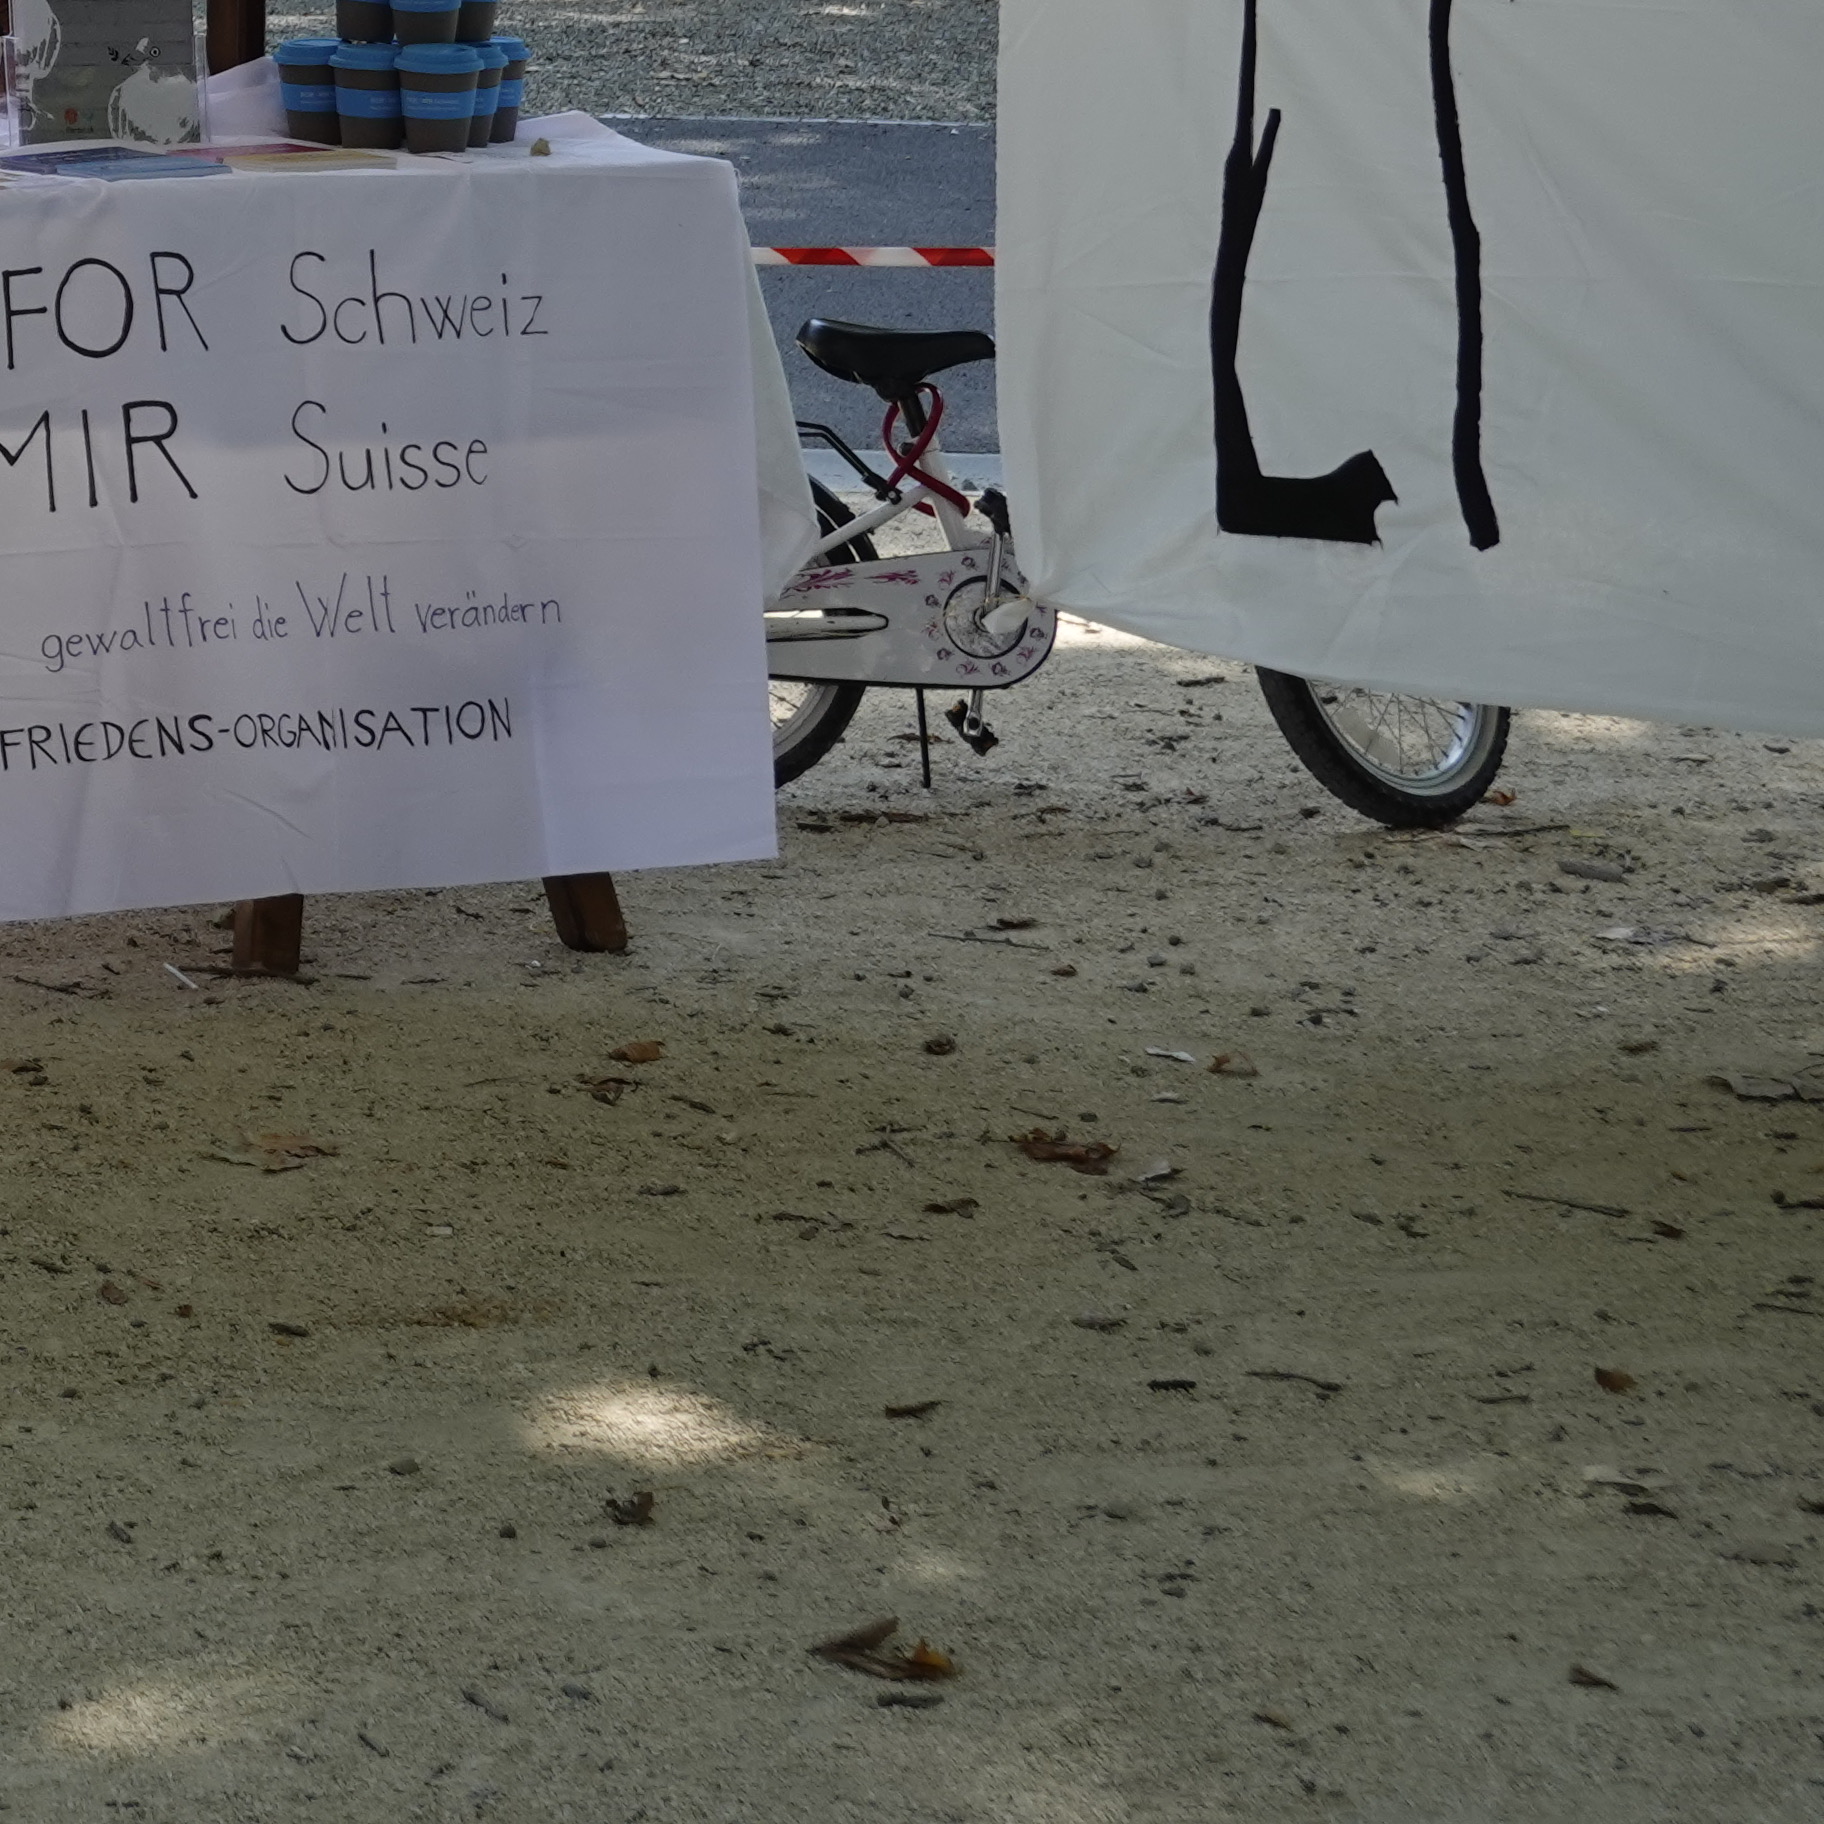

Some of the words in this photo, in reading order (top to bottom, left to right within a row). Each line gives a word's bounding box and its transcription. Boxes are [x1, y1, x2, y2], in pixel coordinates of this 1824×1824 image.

[280, 249, 549, 346] Schweiz
[284, 399, 489, 495] Suisse
[41, 592, 241, 672] gewaltfrei
[252, 595, 289, 640] die
[296, 573, 393, 636] Welt
[415, 593, 563, 631] verändern
[0, 697, 514, 771] FRIEDENS-ORGANISATION
